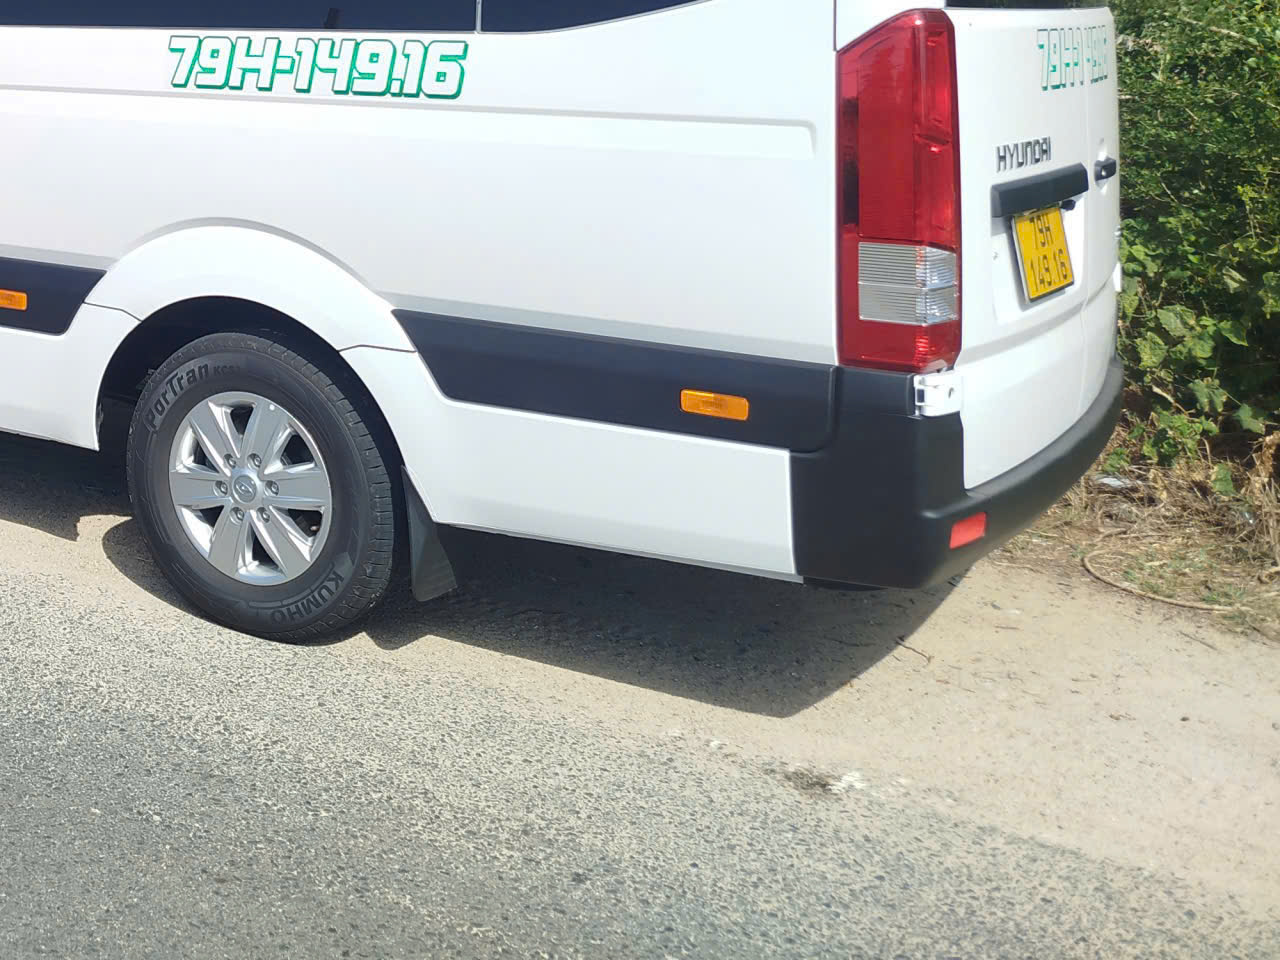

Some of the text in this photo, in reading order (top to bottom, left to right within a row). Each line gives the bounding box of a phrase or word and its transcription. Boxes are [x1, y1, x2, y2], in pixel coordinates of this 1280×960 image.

[168, 35, 469, 100] 79H-149.16
[996, 136, 1052, 173] HYUNDAI
[1029, 213, 1054, 250] 79H
[270, 569, 345, 623] KUMHO
